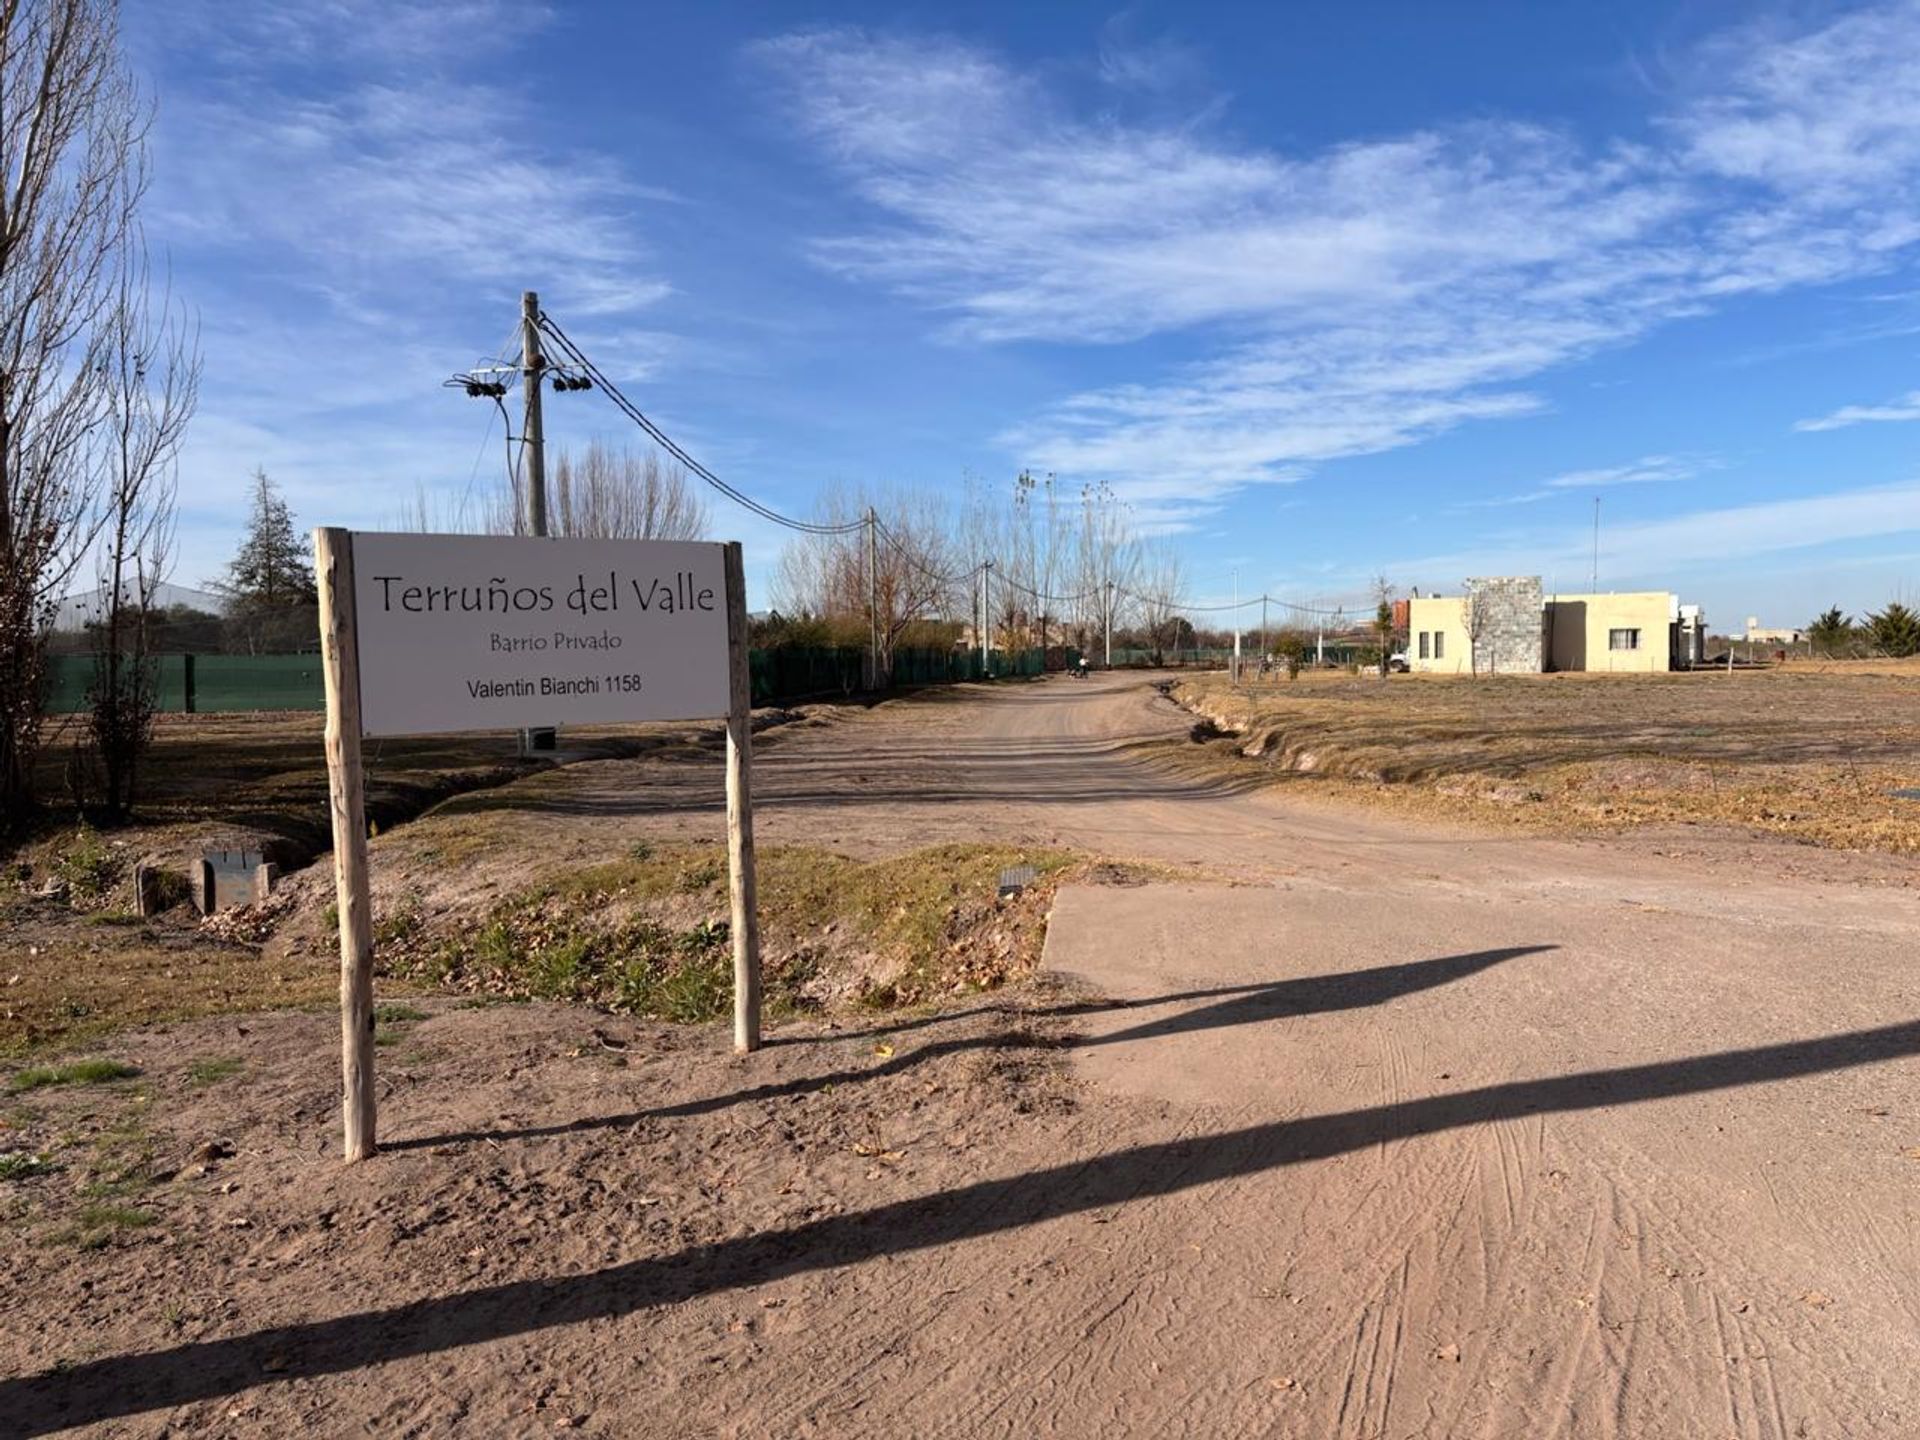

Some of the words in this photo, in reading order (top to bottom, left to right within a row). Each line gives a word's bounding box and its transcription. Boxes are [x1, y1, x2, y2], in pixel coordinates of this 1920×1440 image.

[373, 576, 554, 614] Terruños
[567, 571, 618, 616] del
[632, 571, 715, 615] Valle
[490, 633, 548, 653] Barrio
[555, 630, 622, 650] Privado
[466, 679, 536, 699] Valentin
[541, 677, 600, 696] Bianchi
[605, 674, 642, 693] 1158
